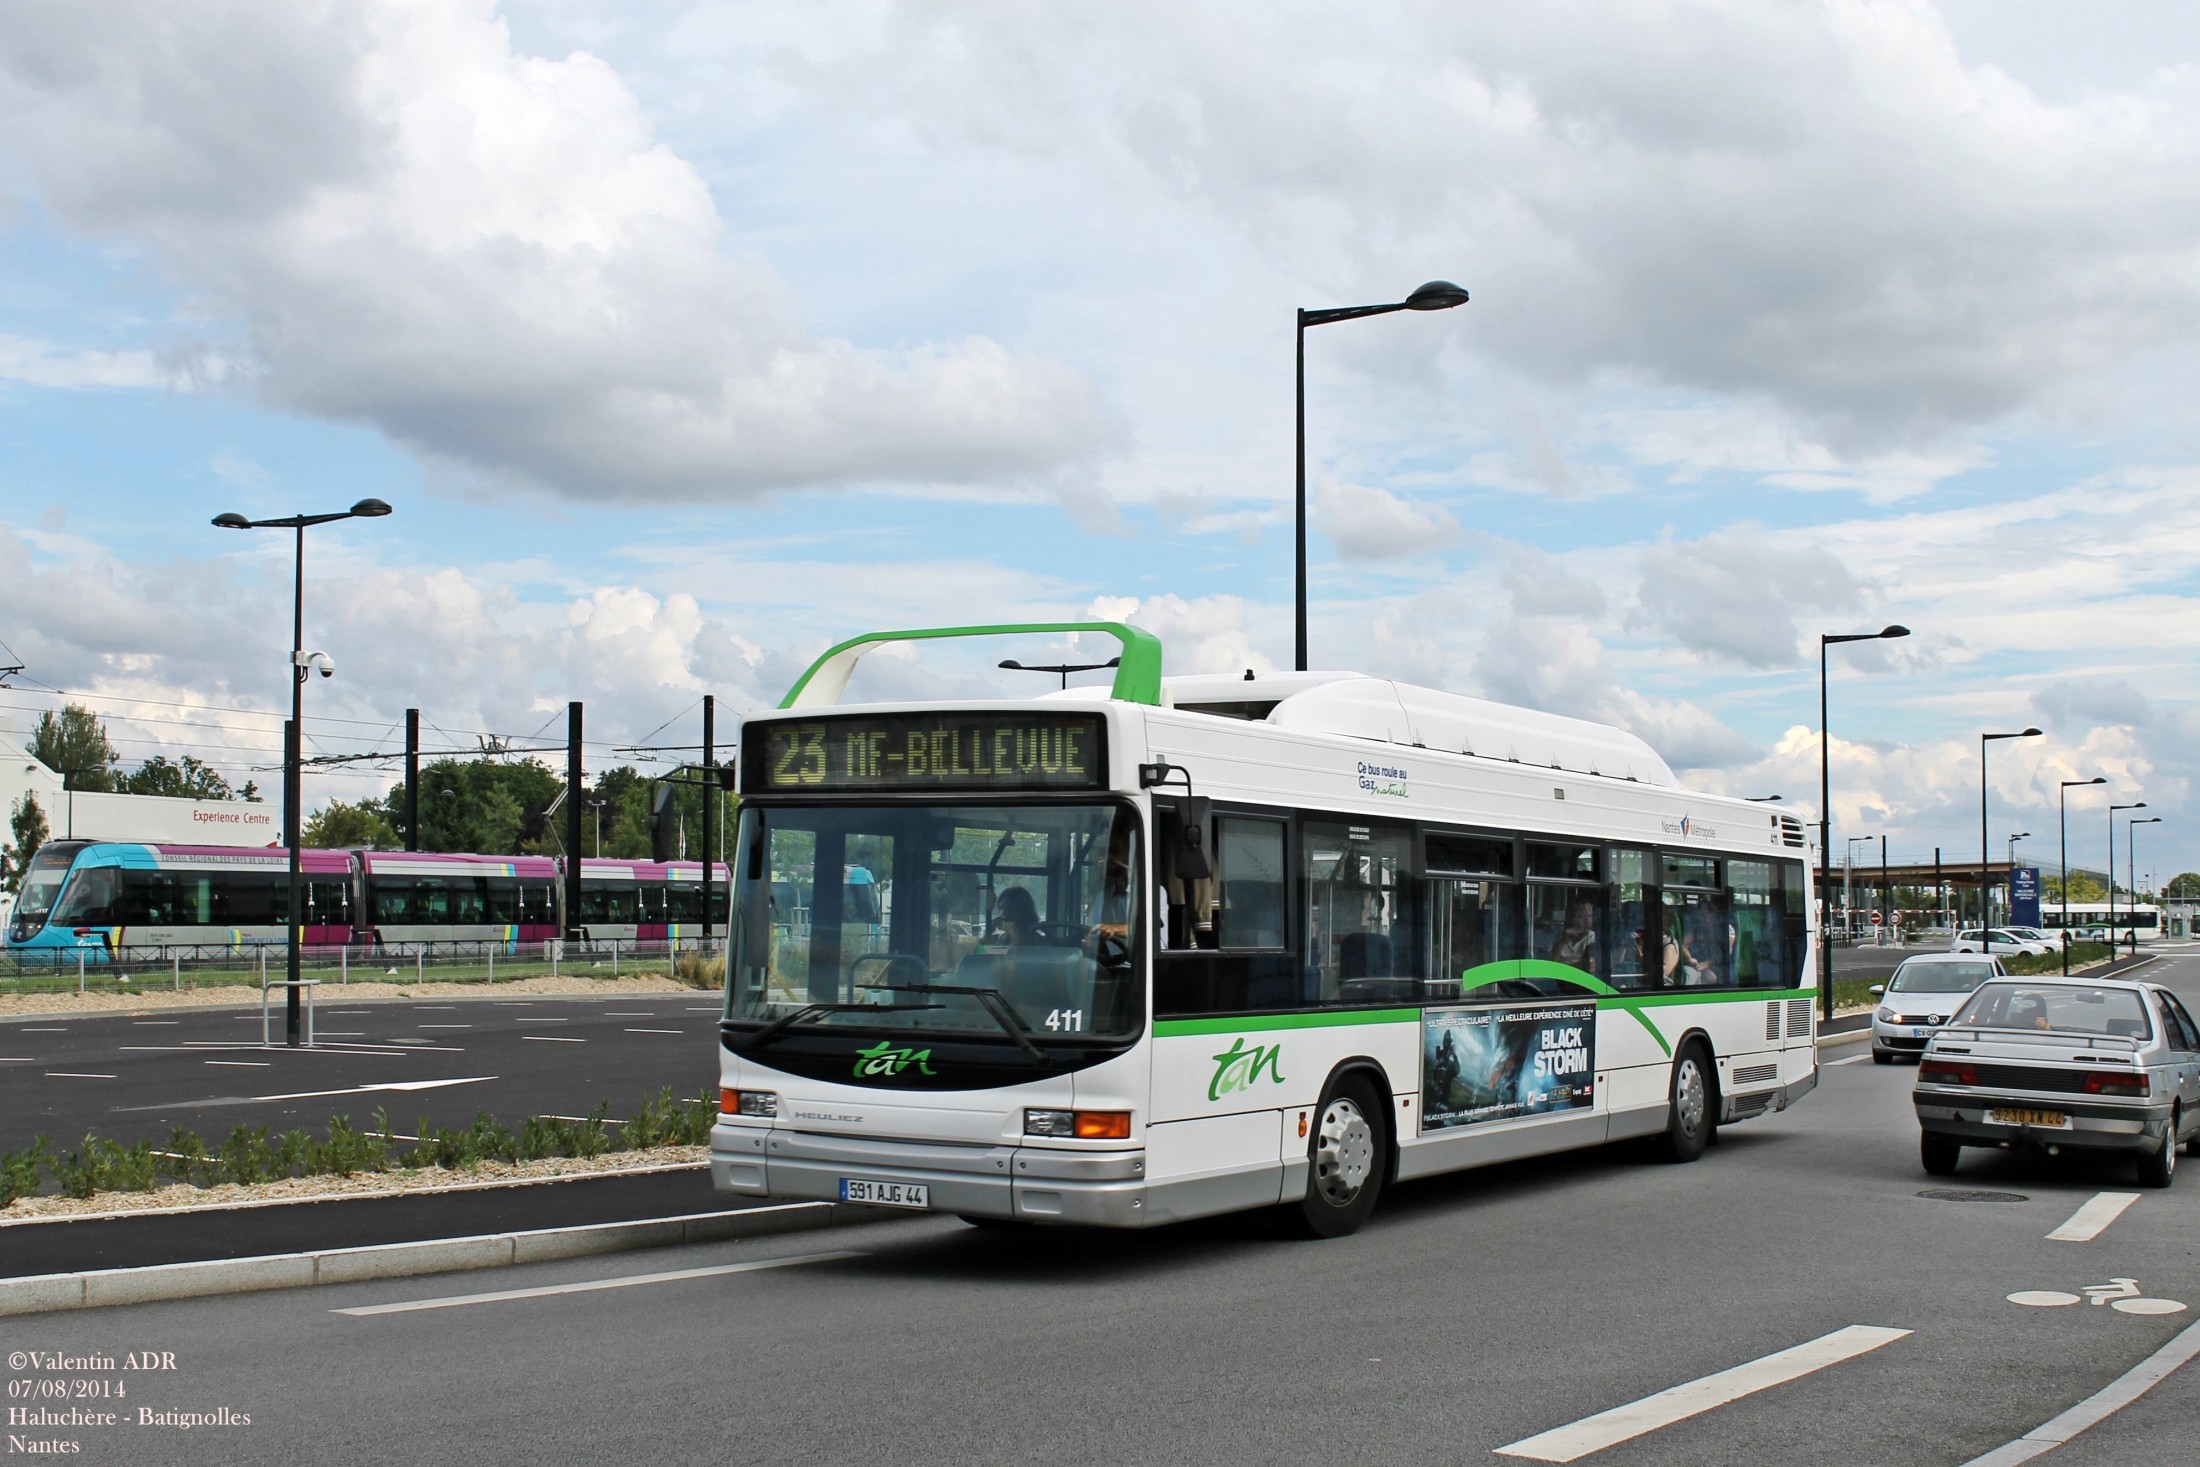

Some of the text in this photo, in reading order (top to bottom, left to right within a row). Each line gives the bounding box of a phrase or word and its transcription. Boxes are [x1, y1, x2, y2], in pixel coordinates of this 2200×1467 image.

[773, 724, 826, 784] 23
[1357, 761, 1407, 779] Ce bus roule au
[1358, 775, 1409, 798] Gaz naturel
[193, 810, 270, 825] Experience Centre
[1661, 820, 1681, 835] Nantes
[161, 854, 188, 863] CONSEIL
[219, 856, 231, 864] DES
[232, 856, 248, 865] PAYS
[248, 857, 257, 865] DE
[260, 857, 266, 865] LA
[267, 857, 284, 865] LOIRE
[1045, 1009, 1083, 1032] 411
[1505, 1012, 1533, 1022] MEILLEURE
[1533, 1009, 1562, 1020] EXPÉRIENCE
[1563, 1008, 1574, 1018] CINÉ
[1541, 1027, 1583, 1050] BLACK
[853, 1041, 938, 1078] tan
[1208, 1037, 1286, 1101] tan
[1533, 1048, 1588, 1078] STORM
[795, 1111, 864, 1123] HEULIEZ
[2048, 1111, 2062, 1125] 44
[849, 1182, 923, 1204] 591 AJG 44
